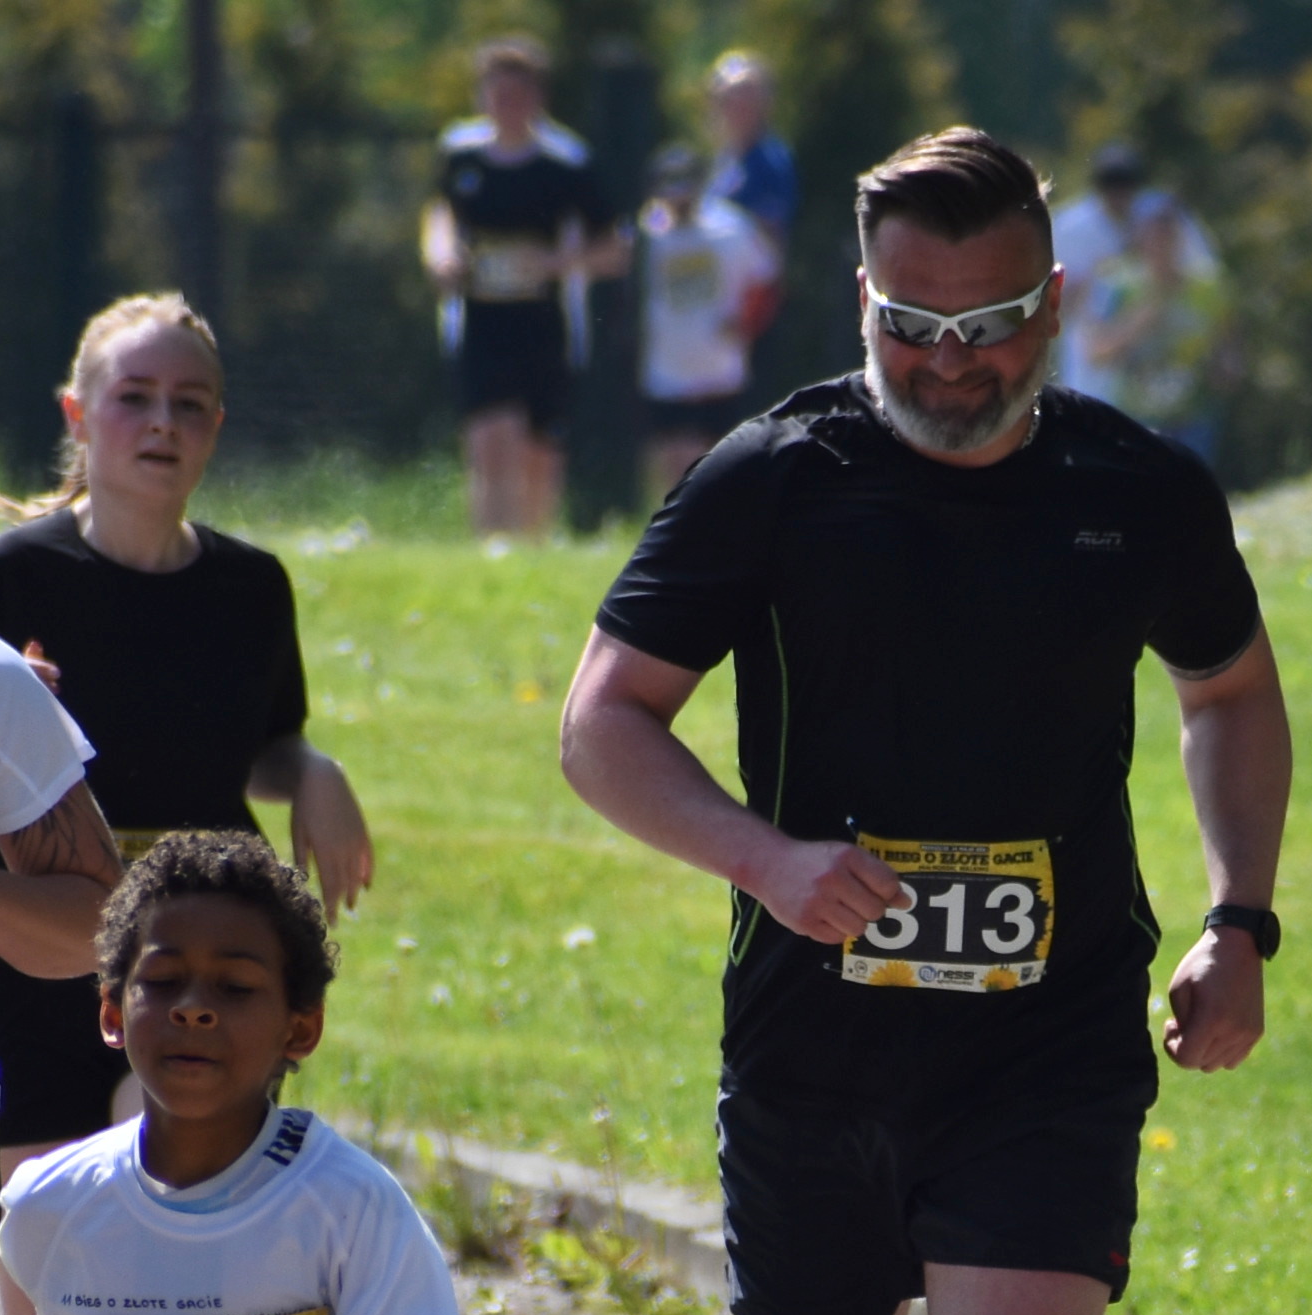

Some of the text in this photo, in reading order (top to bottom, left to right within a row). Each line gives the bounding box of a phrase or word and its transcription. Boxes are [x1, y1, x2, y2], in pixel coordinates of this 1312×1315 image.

[885, 850, 921, 863] BIEG
[924, 852, 937, 864] O
[993, 851, 1034, 865] GACIE
[865, 881, 1036, 955] 313
[61, 1294, 72, 1306] 11
[107, 1297, 116, 1307] O
[123, 1297, 168, 1310] ZŁOTE
